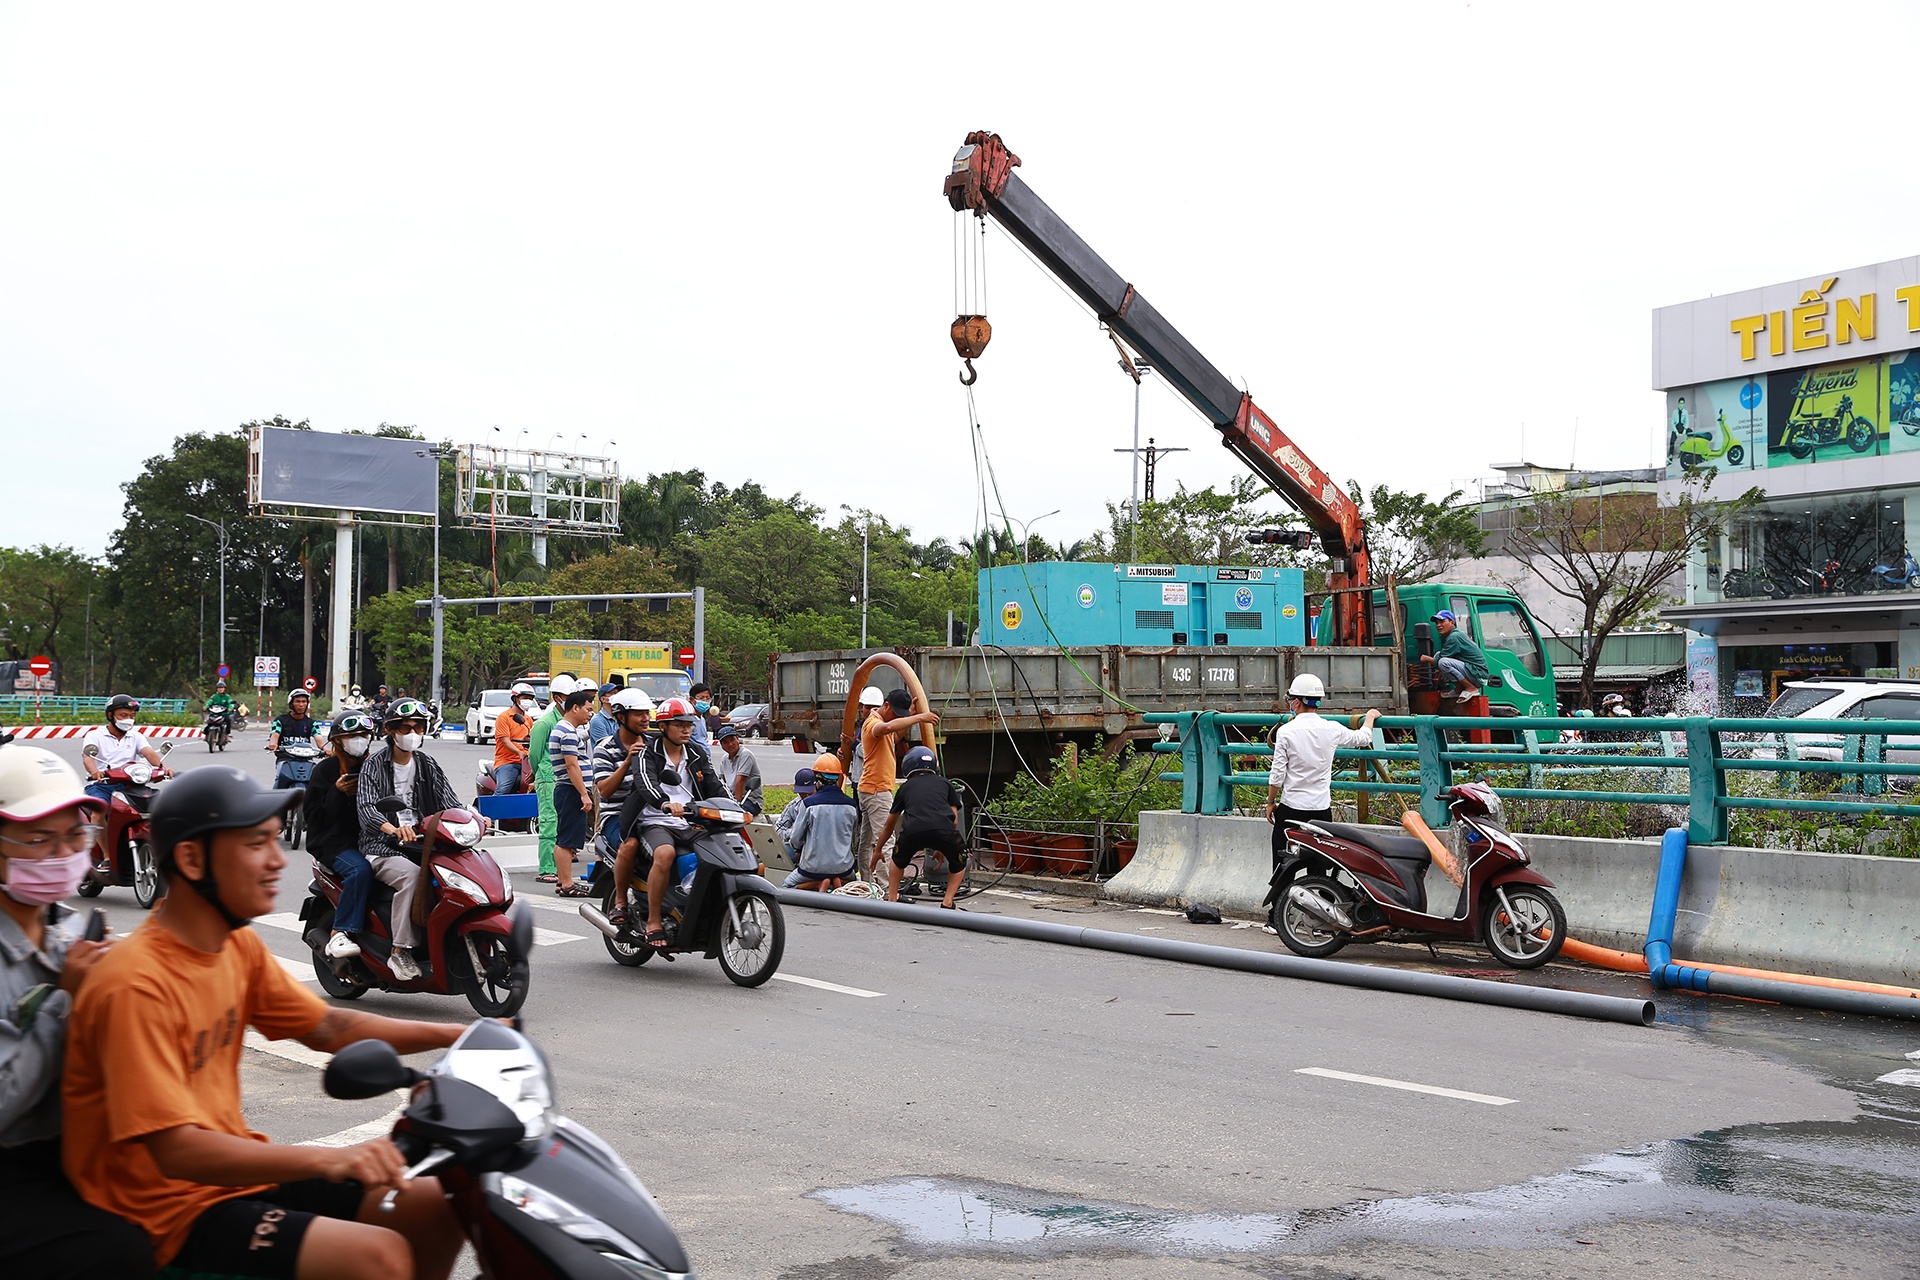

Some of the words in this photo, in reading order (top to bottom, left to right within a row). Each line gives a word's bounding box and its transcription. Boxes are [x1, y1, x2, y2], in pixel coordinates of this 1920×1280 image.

[1731, 277, 1876, 361] TIẾN
[1791, 367, 1859, 400] Legend
[1250, 415, 1271, 443] UNIC
[1136, 568, 1175, 576] MITSUBISHI
[1249, 570, 1262, 579] 100
[612, 650, 623, 660] XE
[625, 649, 643, 660] THƯ
[829, 663, 846, 678] 43C
[1172, 667, 1192, 681] 43C
